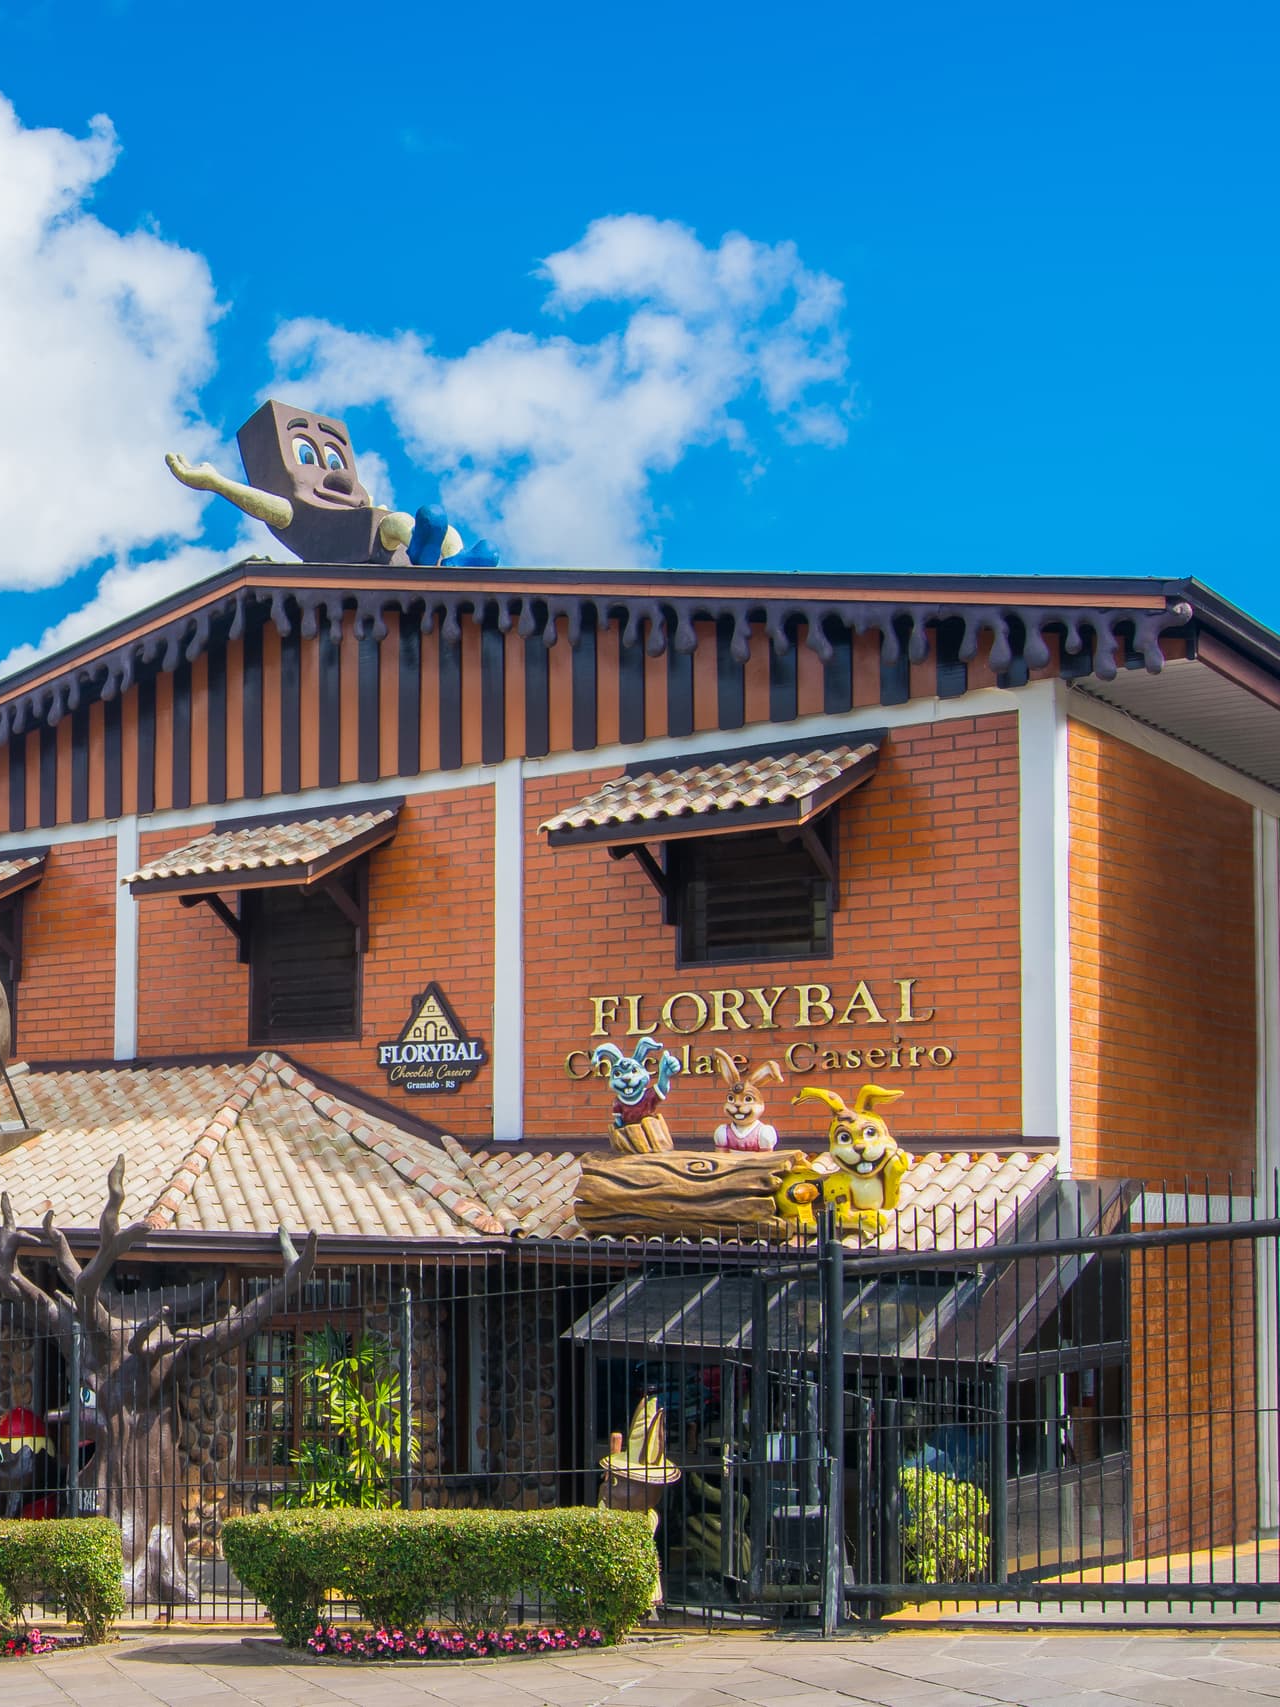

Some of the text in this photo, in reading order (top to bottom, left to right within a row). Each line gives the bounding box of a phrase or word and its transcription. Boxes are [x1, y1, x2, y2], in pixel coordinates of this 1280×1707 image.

[589, 979, 936, 1037] FLORYBAL
[379, 1041, 483, 1065] FLORYBAL
[564, 1035, 954, 1081] Chclae Caseiro
[390, 1063, 472, 1081] Chocolate Caseiro
[406, 1080, 440, 1089] Gramado
[445, 1080, 456, 1089] RS
